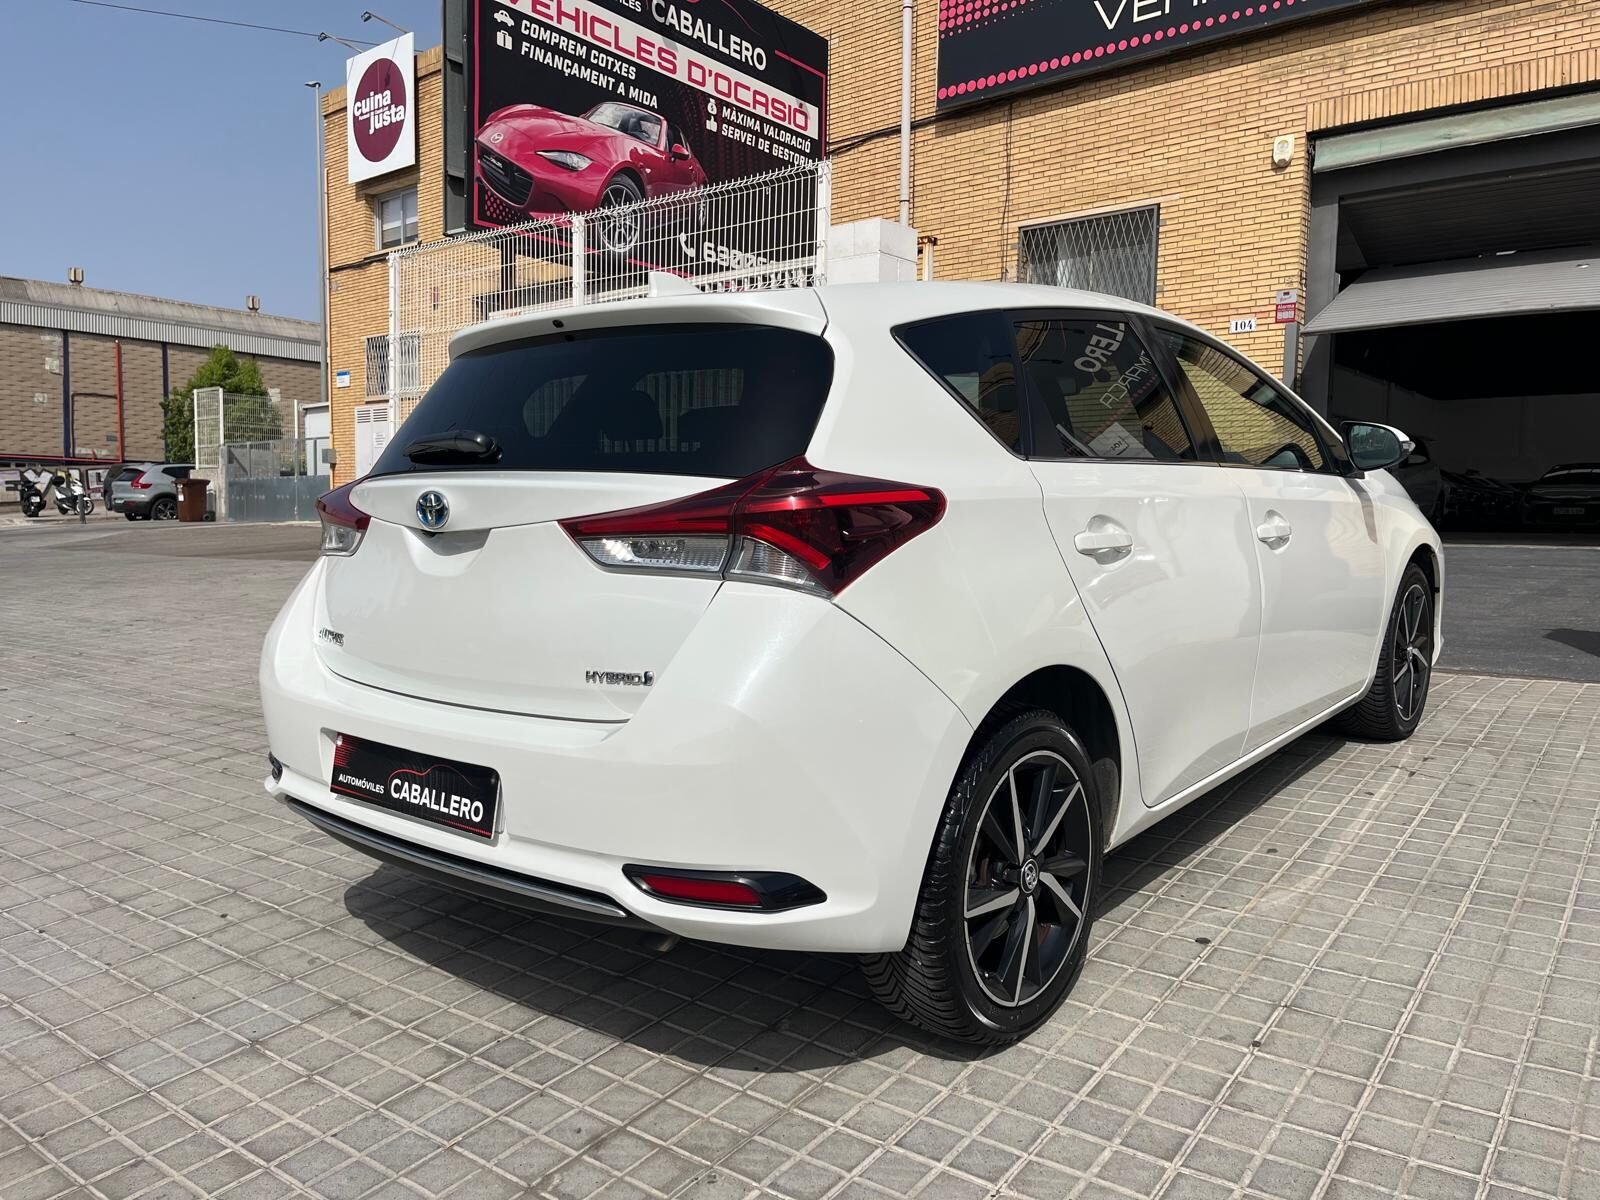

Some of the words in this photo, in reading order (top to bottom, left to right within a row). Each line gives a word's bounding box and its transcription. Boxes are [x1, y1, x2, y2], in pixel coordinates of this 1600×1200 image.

[509, 0, 678, 75] EHICLES
[521, 19, 588, 60] COMPREM
[590, 50, 637, 80] COTXES
[651, 0, 767, 71] CABALLERO
[521, 41, 616, 91] FINANÇAMENT
[617, 82, 626, 96] A
[628, 86, 658, 109] MIDA
[353, 89, 392, 117] cuina
[369, 104, 405, 135] justa
[721, 105, 761, 133] MÀXIMA
[763, 122, 811, 154] VALORACIÓ
[721, 123, 756, 148] SERVEI
[758, 138, 770, 153] DE
[1234, 320, 1253, 331] 104
[585, 670, 642, 686] HYBRID
[338, 773, 385, 794] AUTOMÓVILES
[390, 778, 484, 823] CABALLERO
